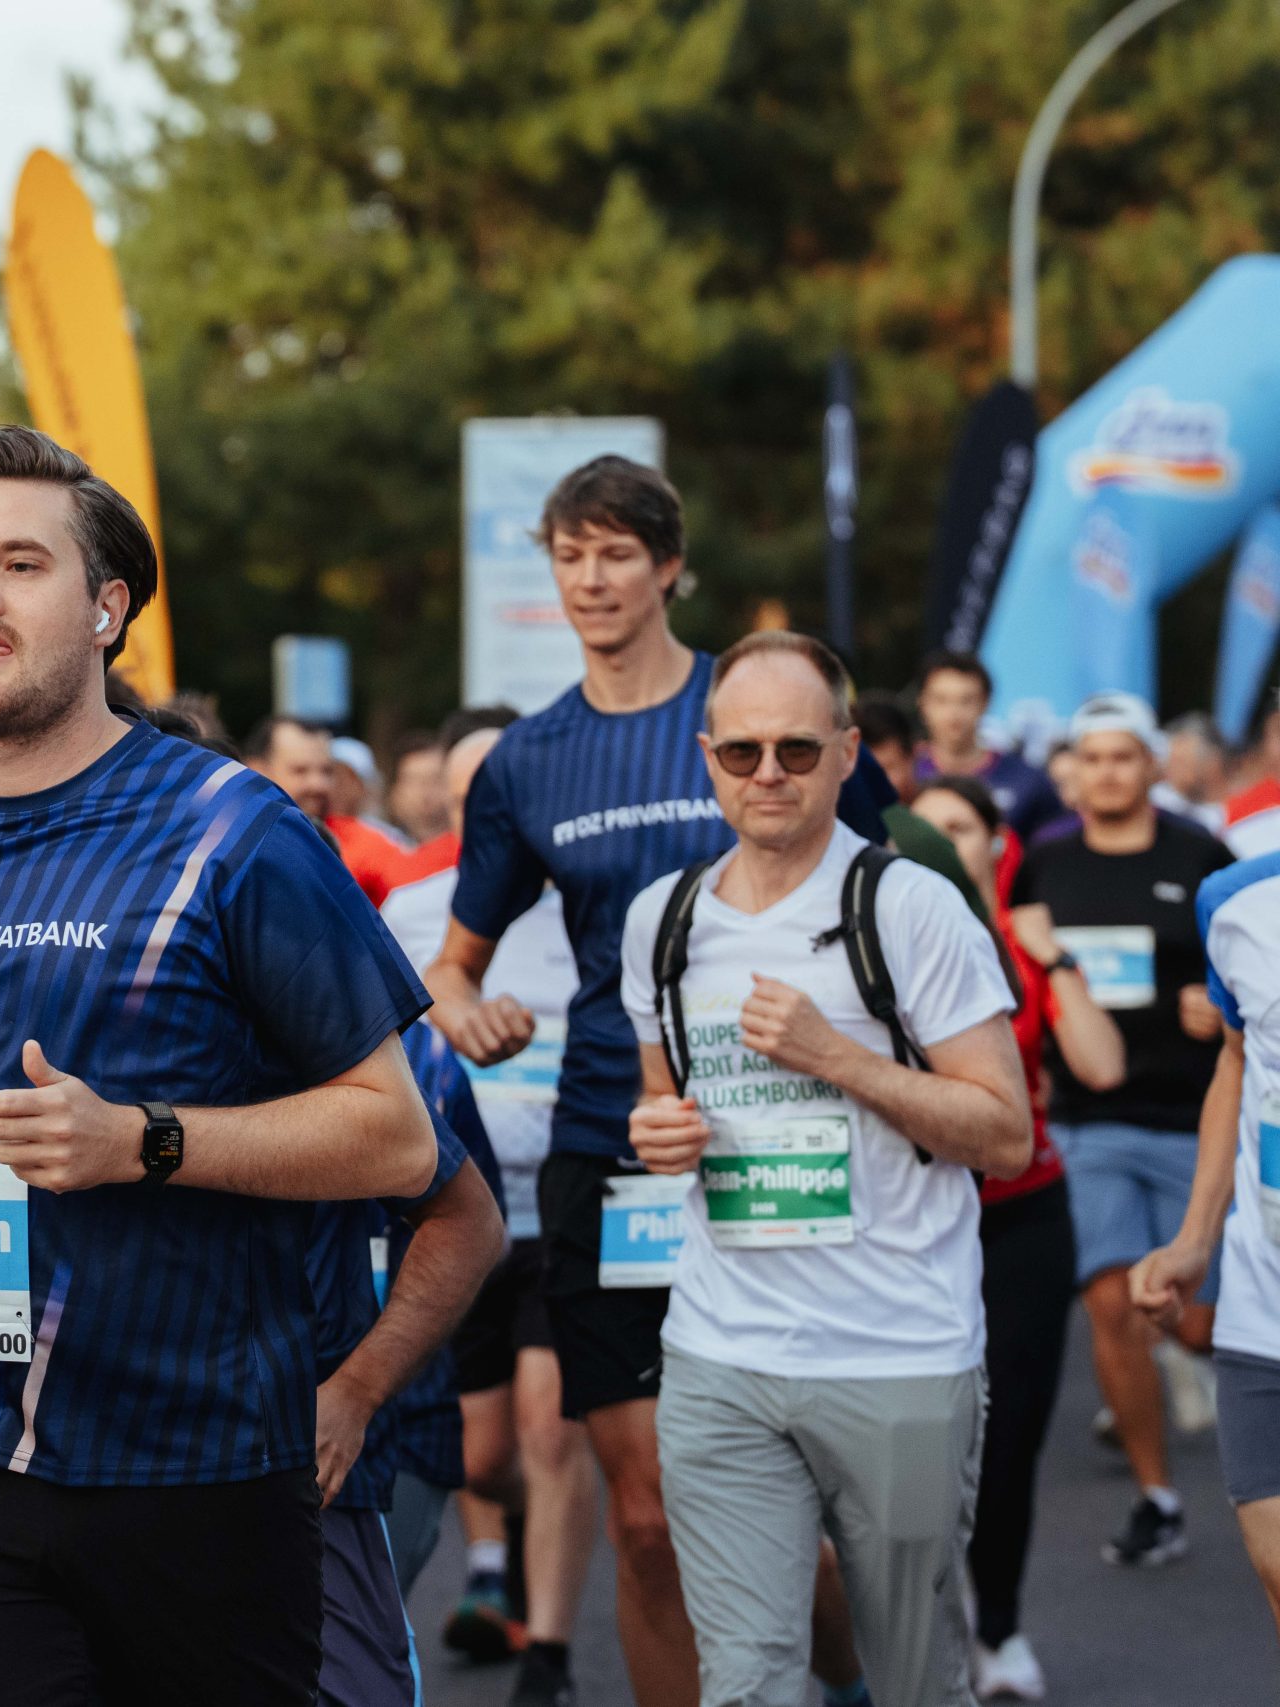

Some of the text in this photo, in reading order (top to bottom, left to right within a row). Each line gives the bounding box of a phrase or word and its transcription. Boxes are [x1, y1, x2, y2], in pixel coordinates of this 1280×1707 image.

[575, 798, 724, 839] DZ PRIVATBAN
[687, 1024, 740, 1048] OUPE
[690, 1054, 733, 1079] EDIT
[704, 1164, 846, 1194] Jean-Philippe
